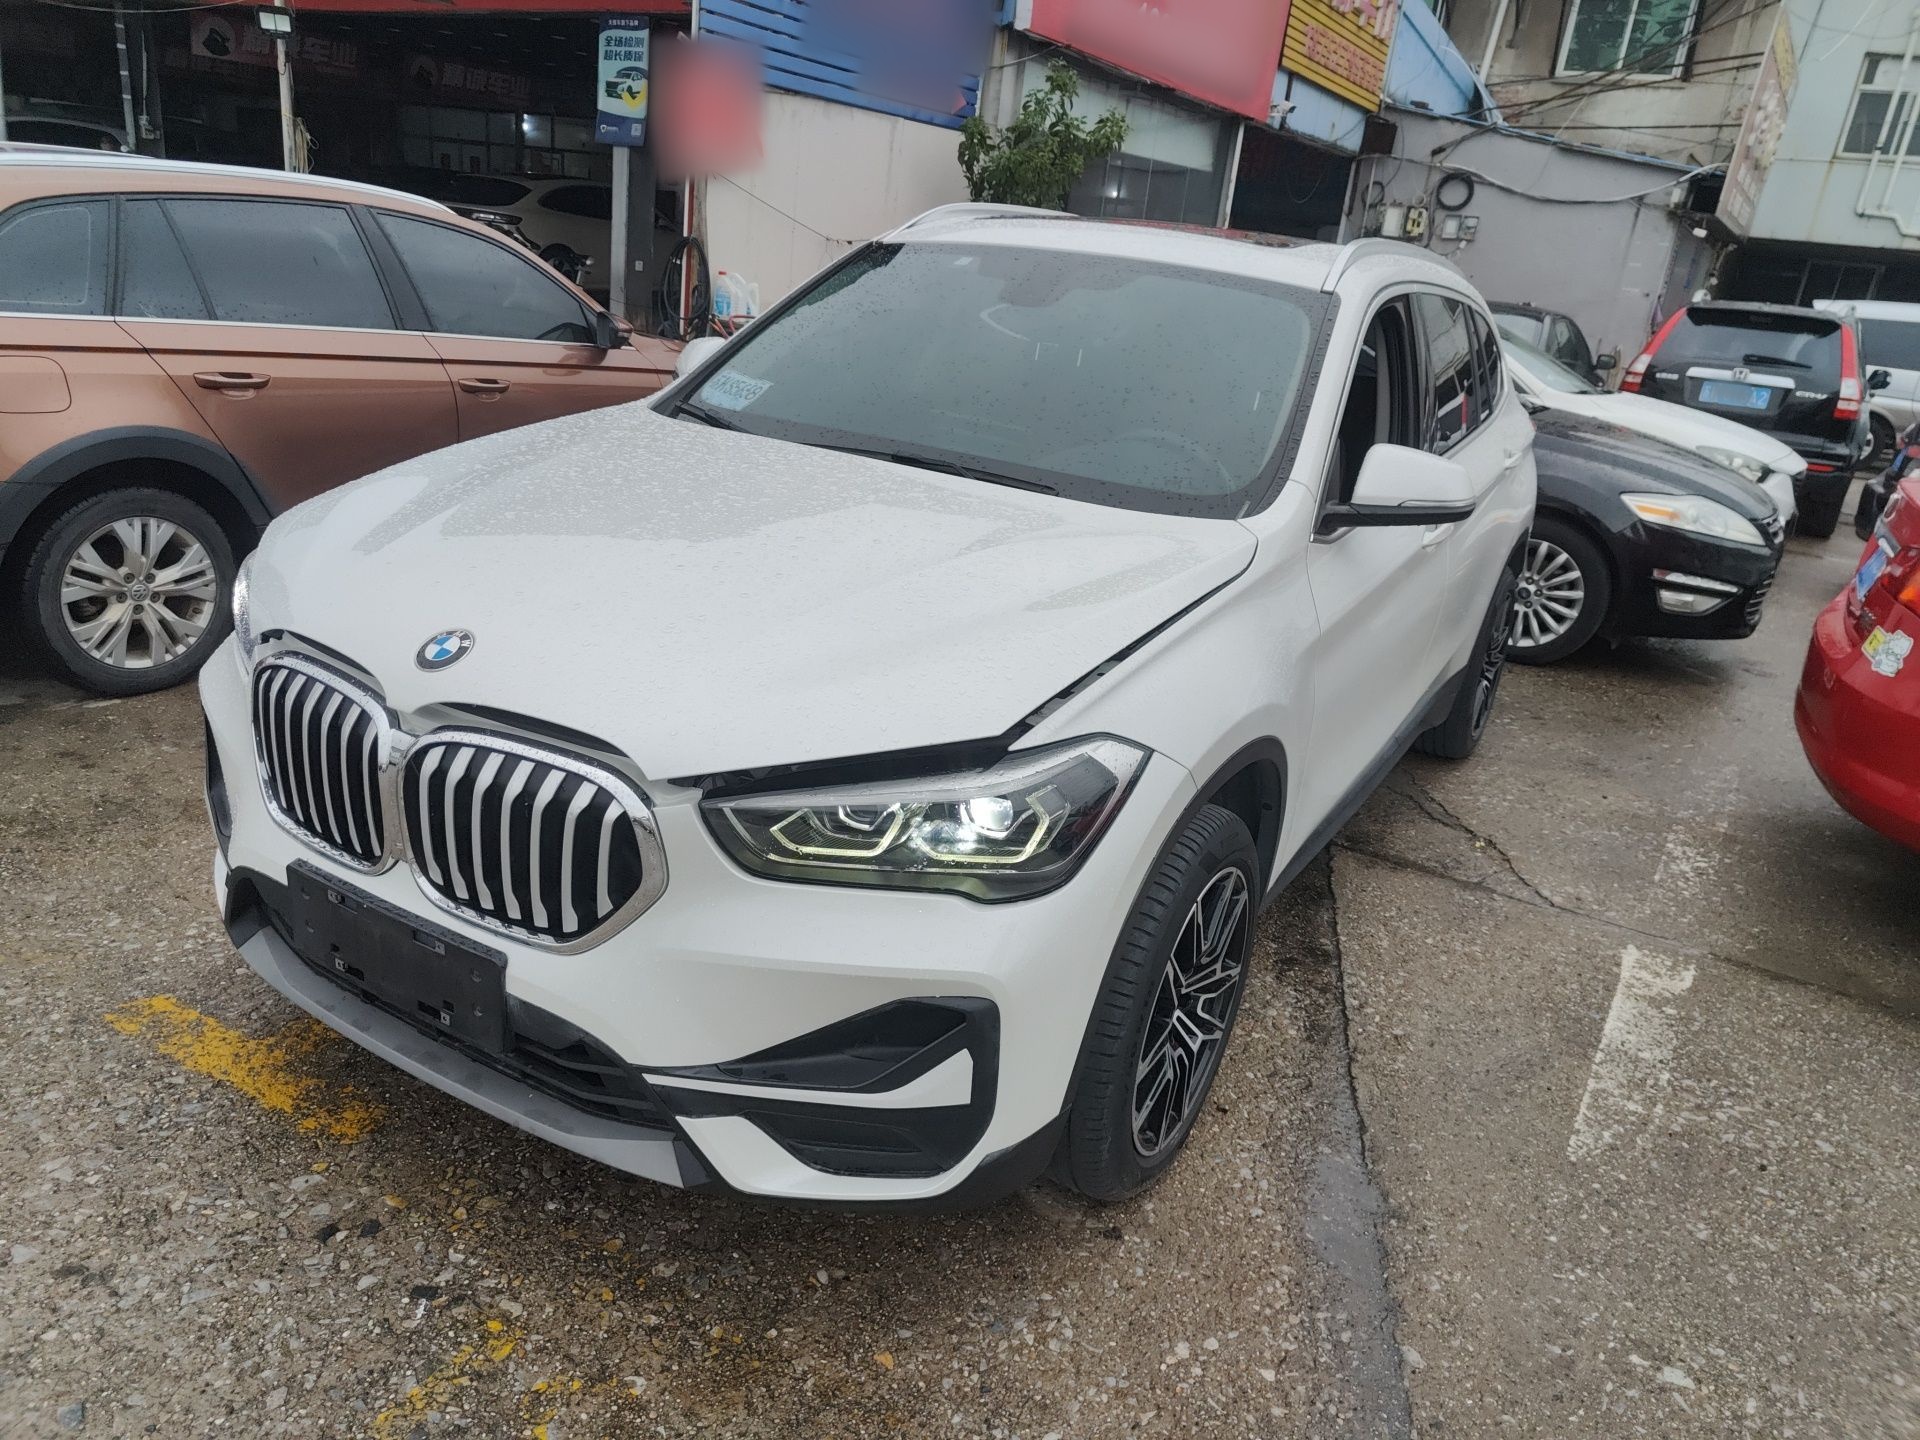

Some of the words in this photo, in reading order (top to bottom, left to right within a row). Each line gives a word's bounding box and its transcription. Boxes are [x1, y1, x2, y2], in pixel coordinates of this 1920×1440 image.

[604, 35, 645, 48] 全场检测
[603, 49, 645, 62] 超长质保
